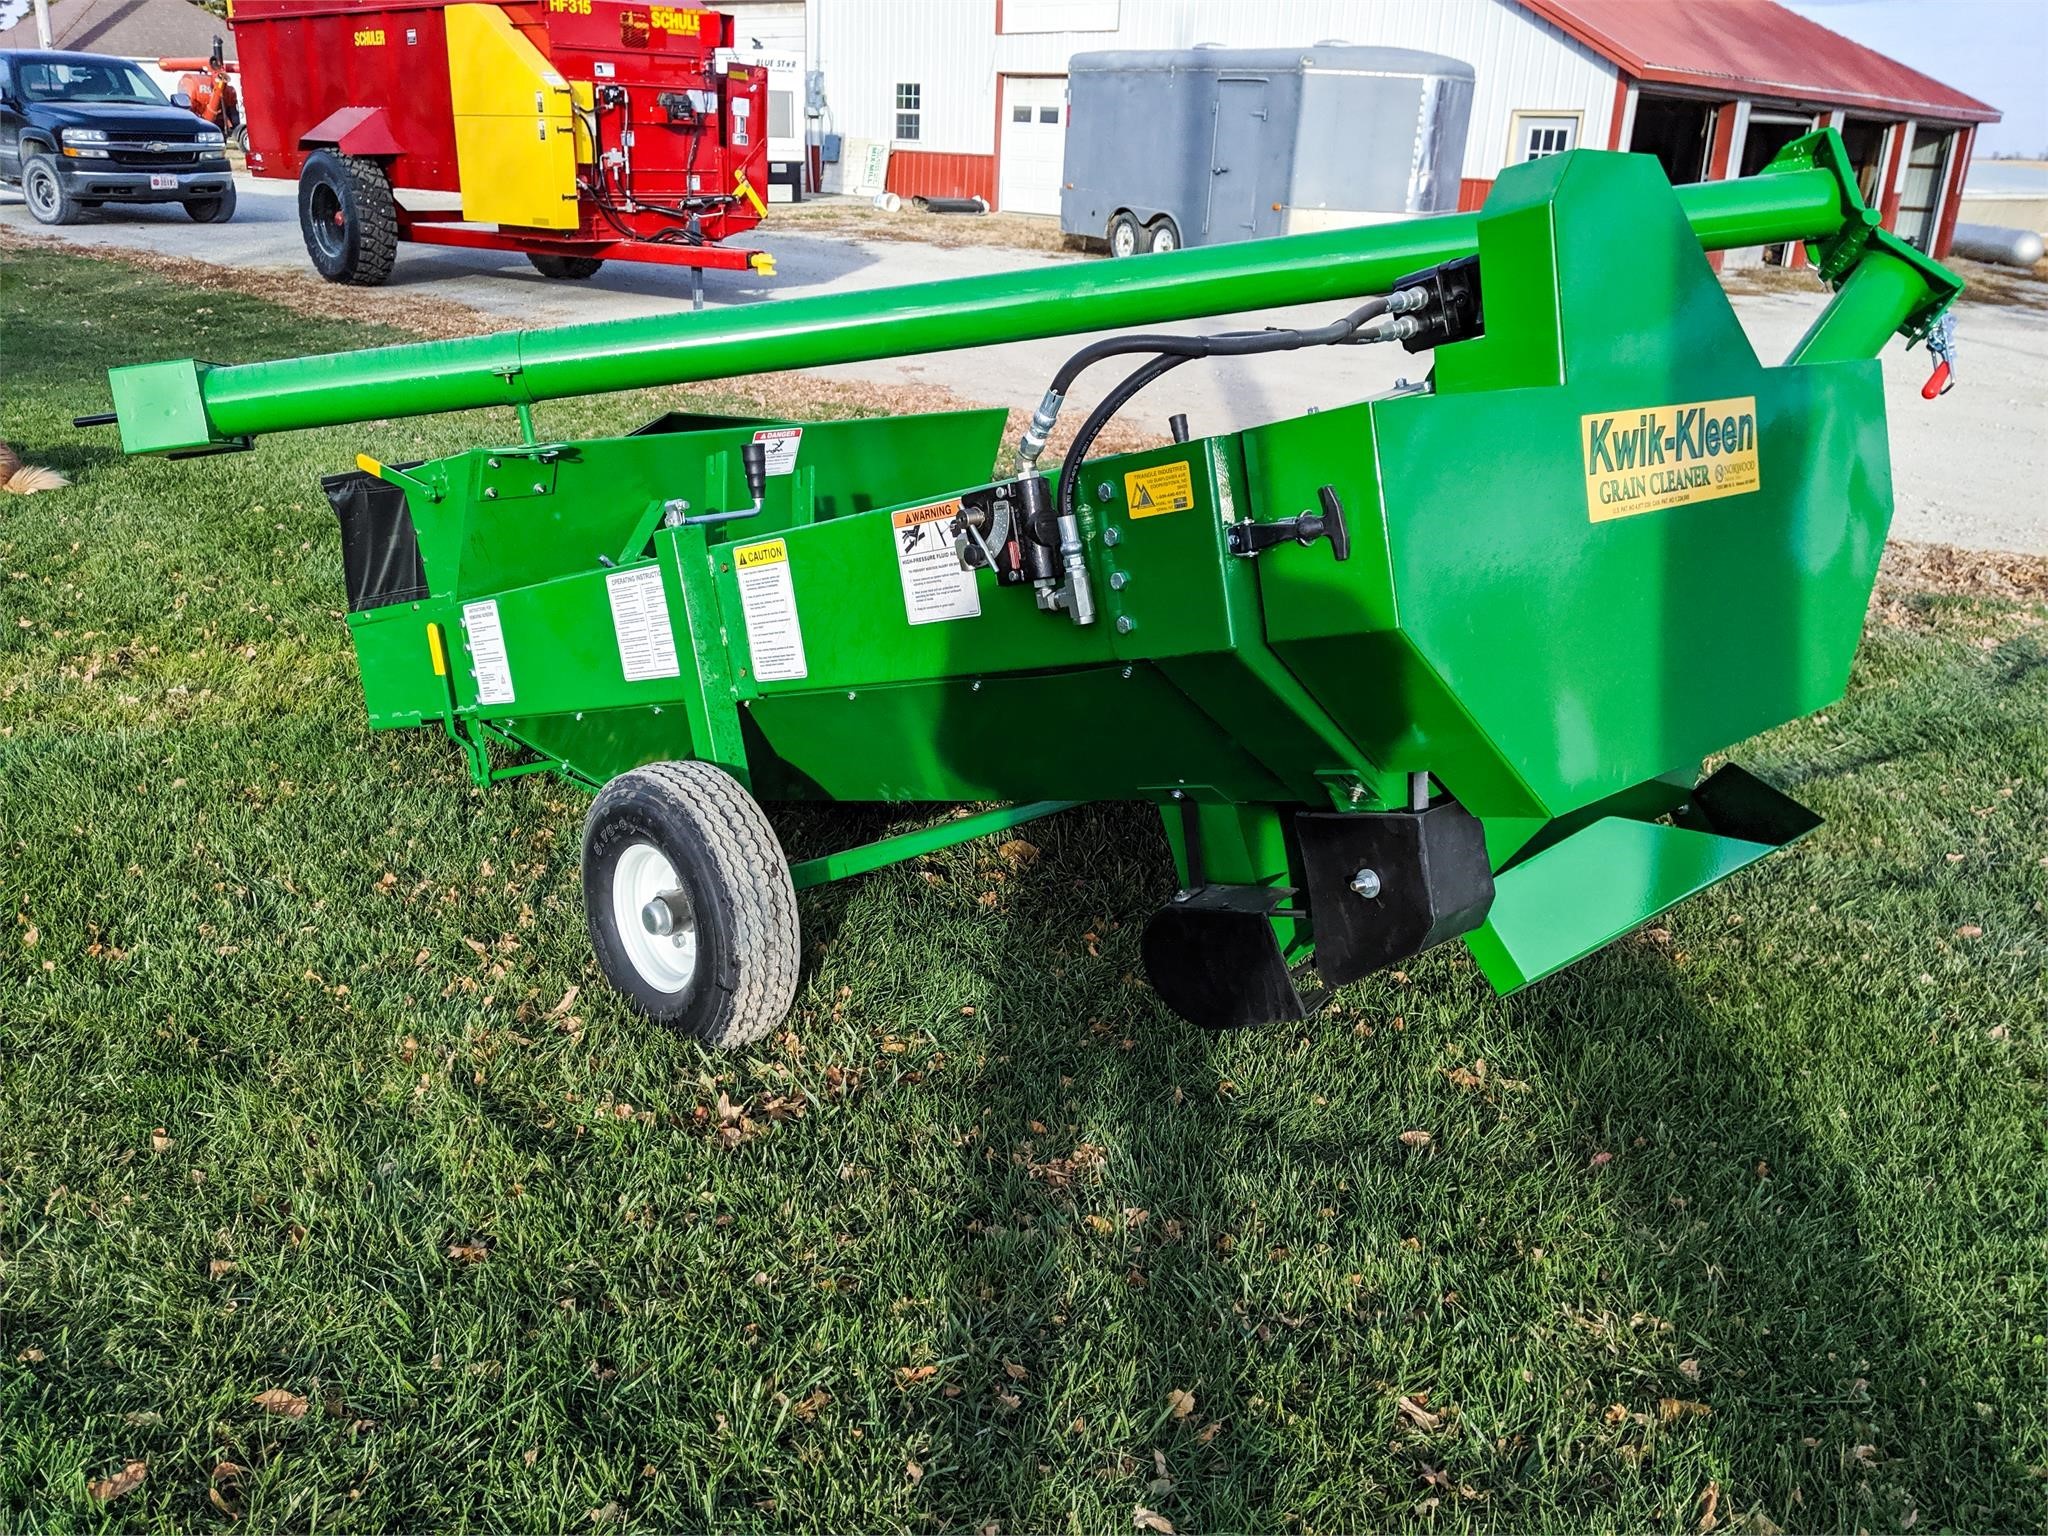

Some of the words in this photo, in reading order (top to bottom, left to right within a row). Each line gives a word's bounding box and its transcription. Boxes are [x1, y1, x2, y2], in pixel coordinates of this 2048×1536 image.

[549, 0, 592, 15] HF315
[354, 30, 386, 47] SCHULER
[767, 430, 796, 439] DANGER
[1589, 407, 1754, 476] Kwik-Kleen
[1135, 470, 1157, 479] TRIANGLE
[1158, 465, 1187, 475] INDUSTRIES
[1599, 475, 1647, 505] GRAIN
[1649, 465, 1711, 496] CLEANER
[911, 504, 952, 523] WARNING
[747, 546, 783, 563] CAUTION
[611, 575, 636, 586] OPERATING
